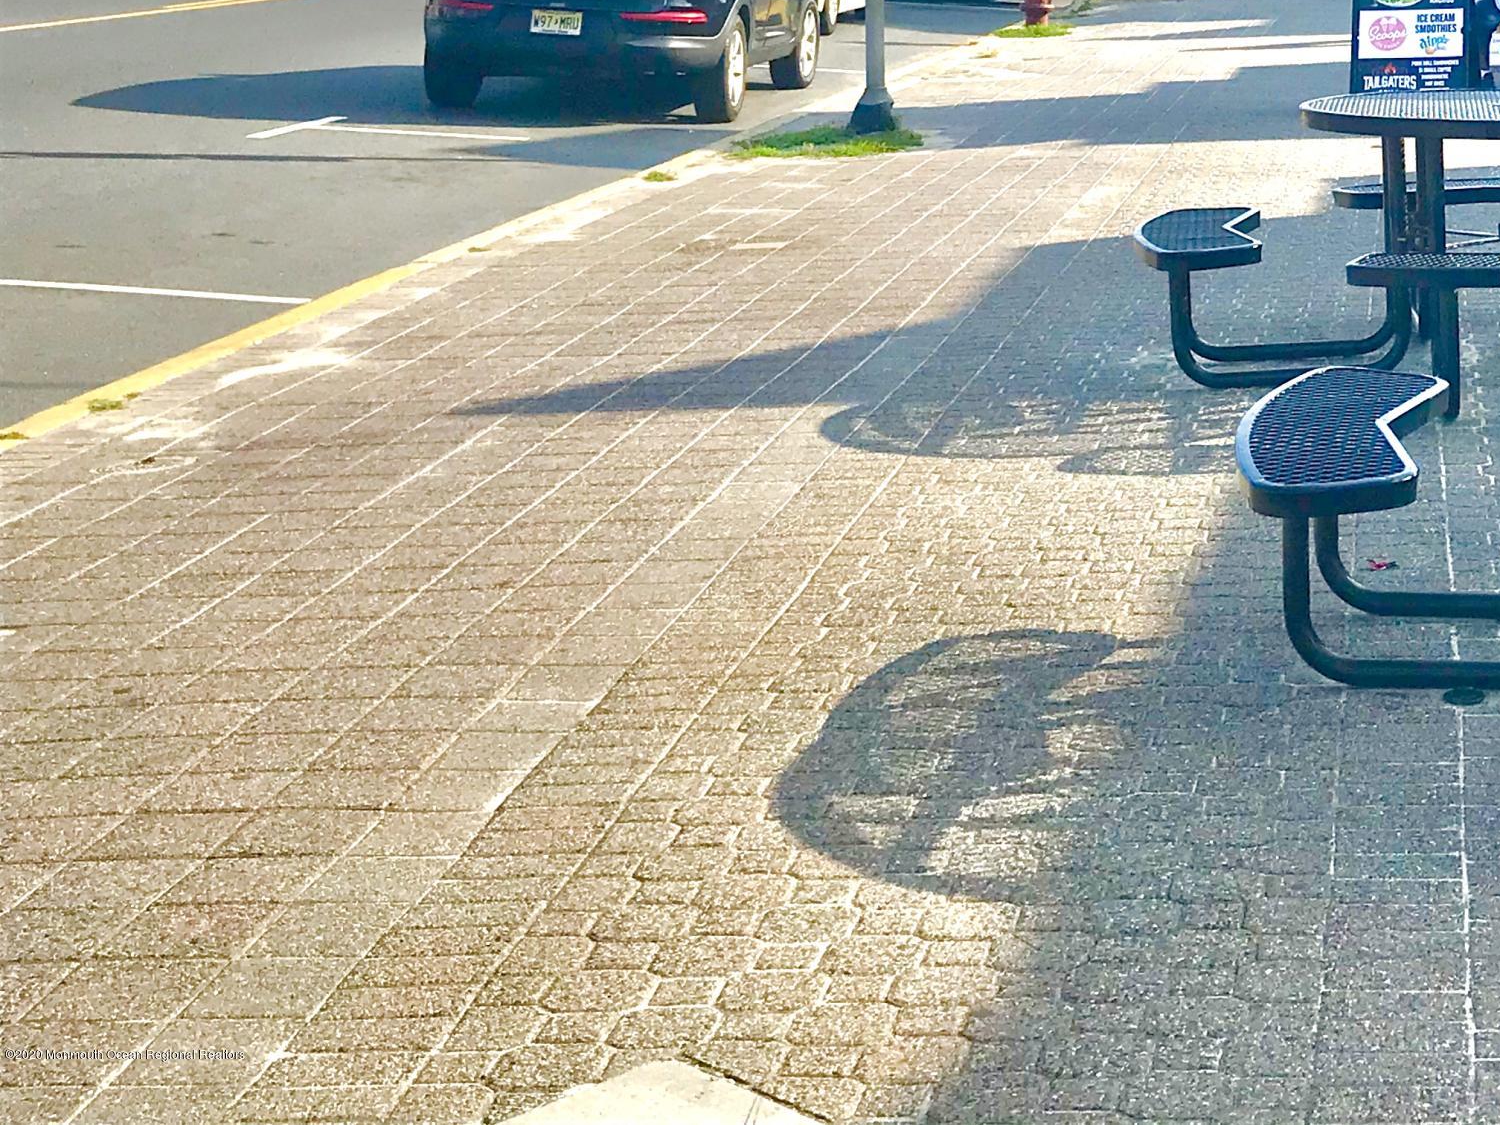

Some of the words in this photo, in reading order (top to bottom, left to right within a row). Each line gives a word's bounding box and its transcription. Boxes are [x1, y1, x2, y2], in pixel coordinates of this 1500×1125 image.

[1416, 14, 1429, 22] ICE
[1430, 13, 1455, 22] CREAM
[1369, 26, 1408, 42] Scoops
[1415, 24, 1457, 34] SMOOTHIES
[1363, 75, 1417, 91] TAILGATERS
